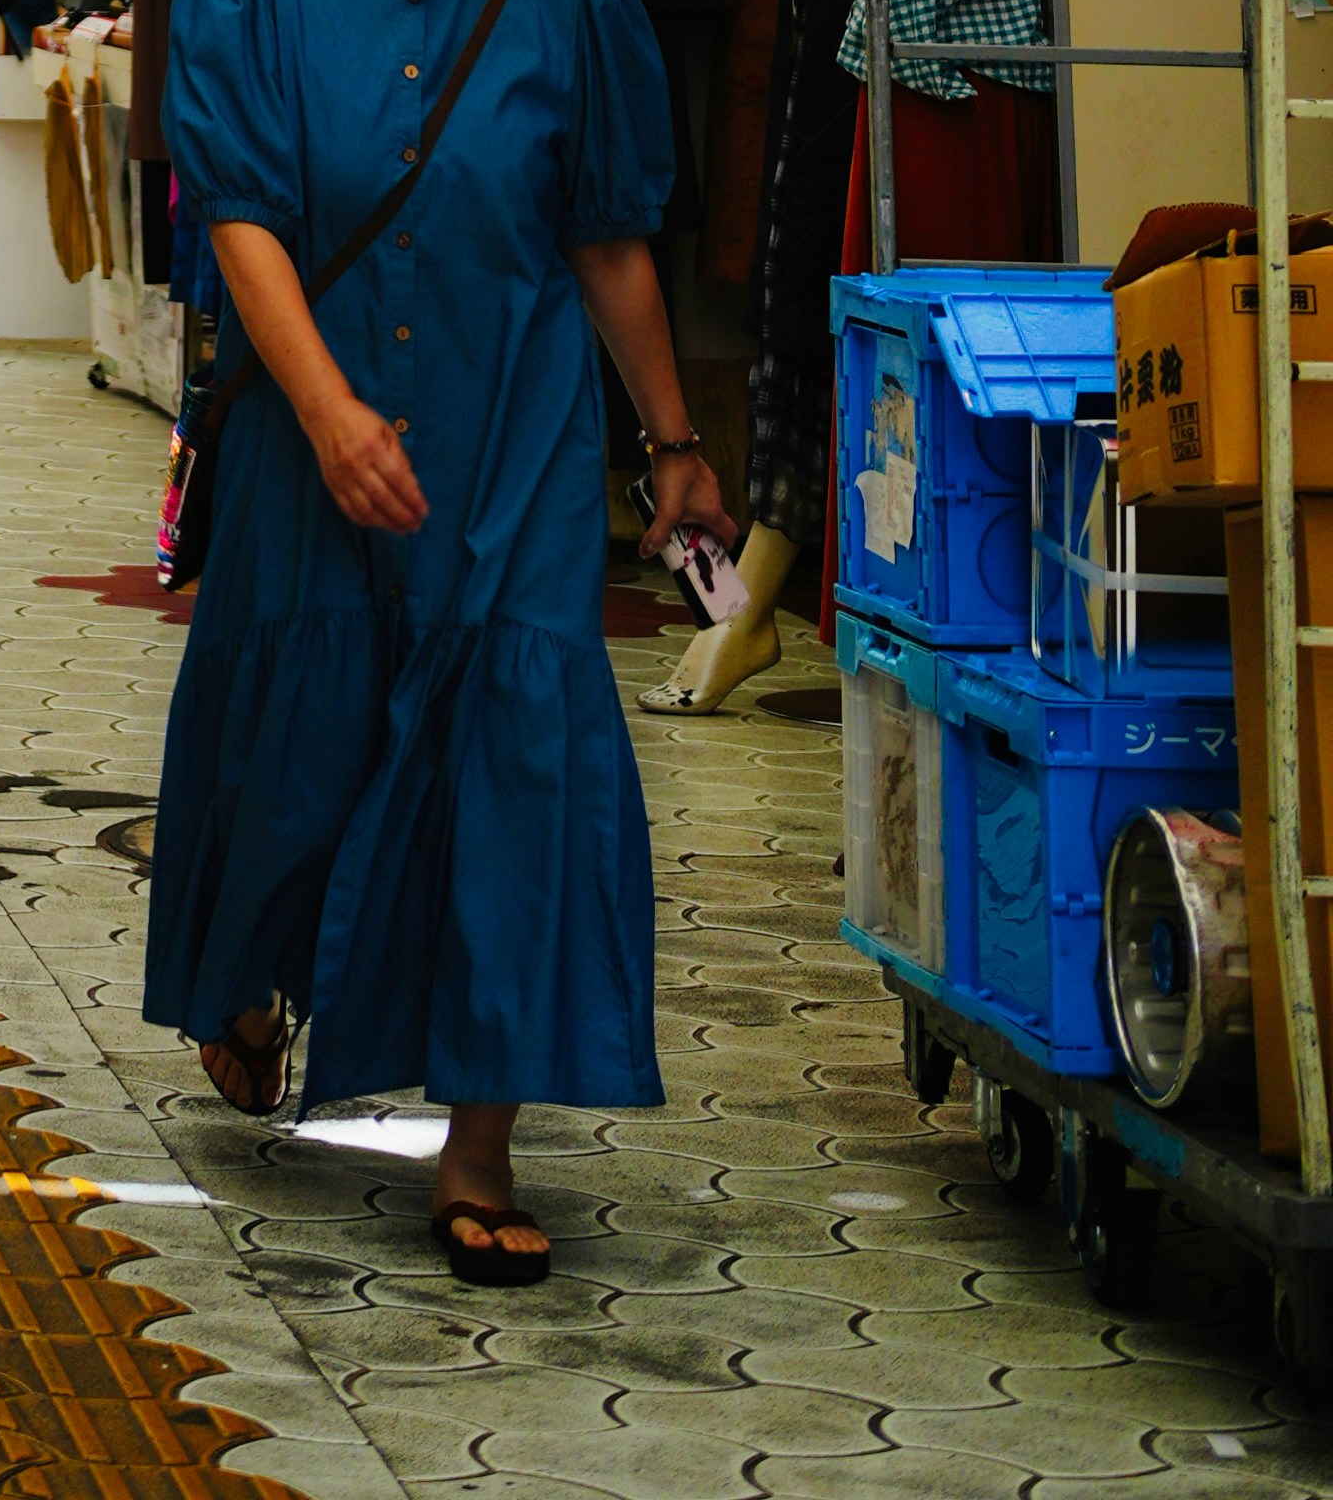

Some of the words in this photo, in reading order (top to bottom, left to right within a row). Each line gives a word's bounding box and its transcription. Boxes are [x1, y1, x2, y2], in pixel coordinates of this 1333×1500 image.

[1240, 288, 1309, 311] 業用
[1119, 343, 1182, 413] 片栗粉
[1174, 426, 1195, 441] 1kg
[1125, 723, 1238, 757] ジーマ
